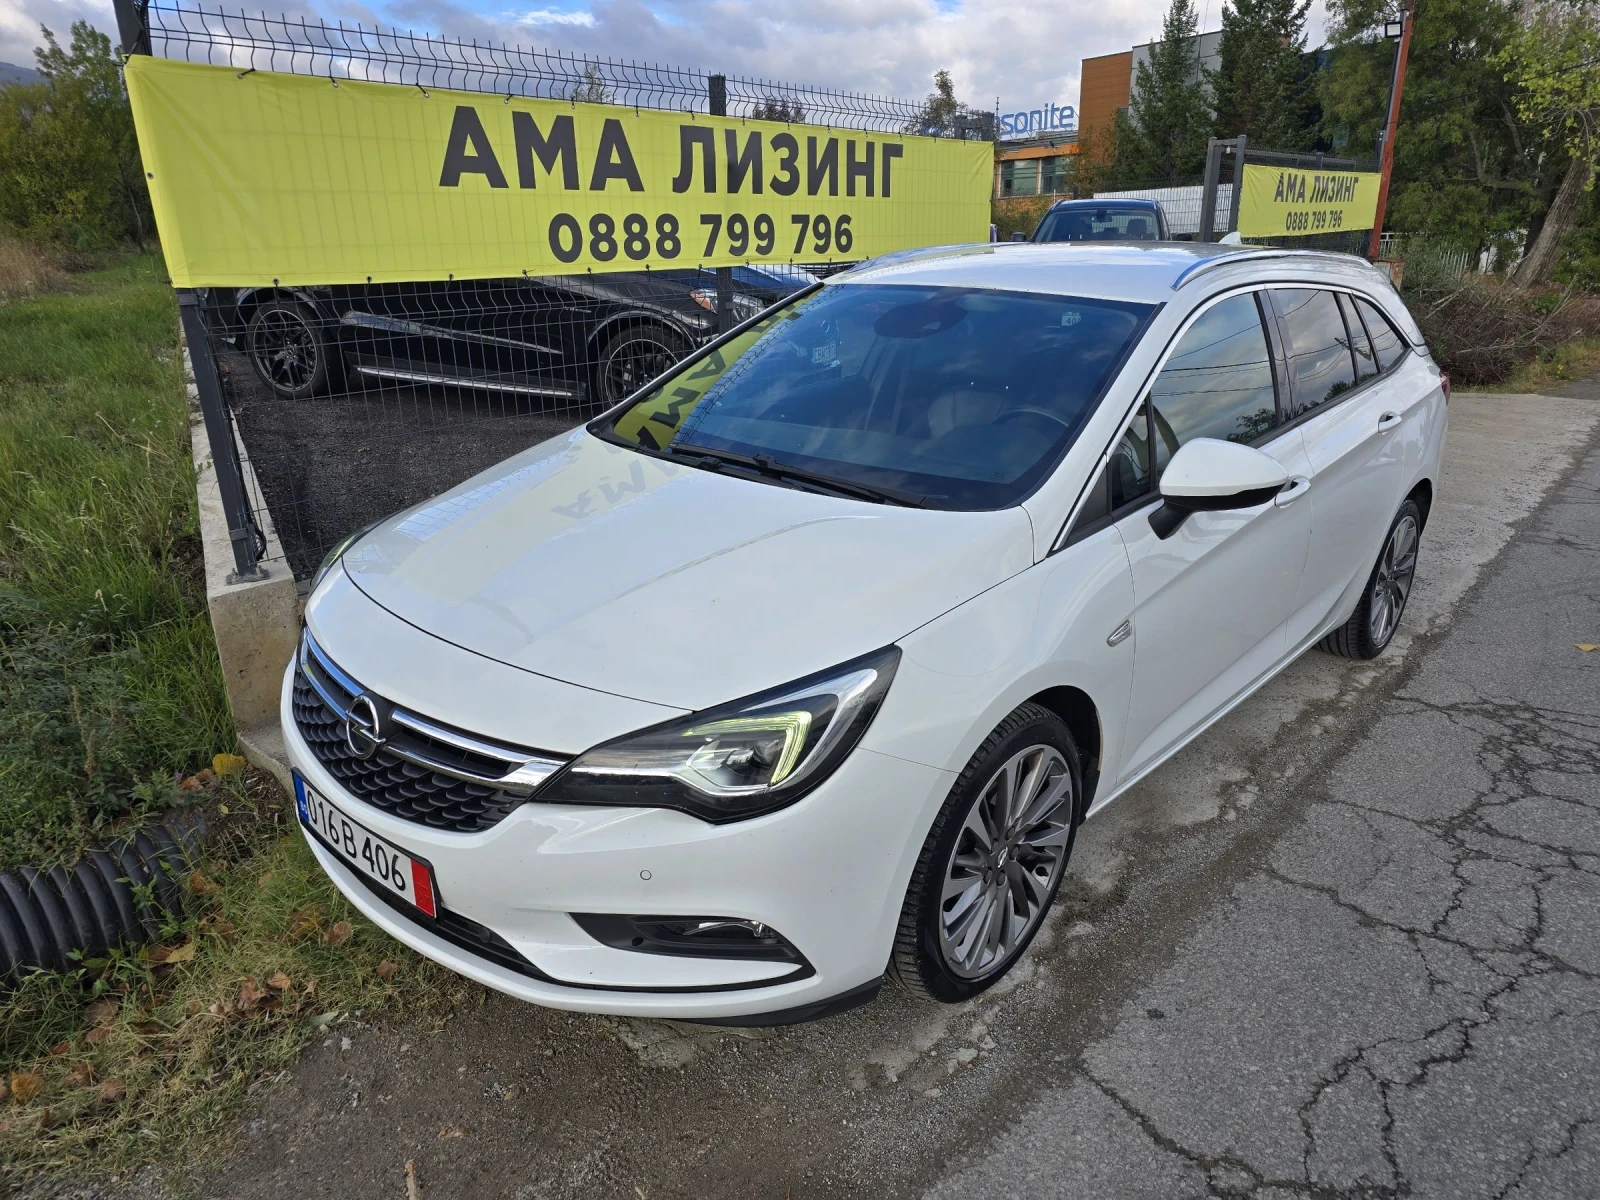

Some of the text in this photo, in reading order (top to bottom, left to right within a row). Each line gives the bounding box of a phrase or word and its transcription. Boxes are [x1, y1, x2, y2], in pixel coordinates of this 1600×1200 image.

[994, 103, 1075, 136] sonite
[439, 105, 904, 198] АМА ЛИЗИНГ
[1273, 172, 1359, 203] АМА ЛИЗИНГ
[1285, 209, 1343, 231] 0888 799 796
[548, 212, 853, 263] 0888 799 796
